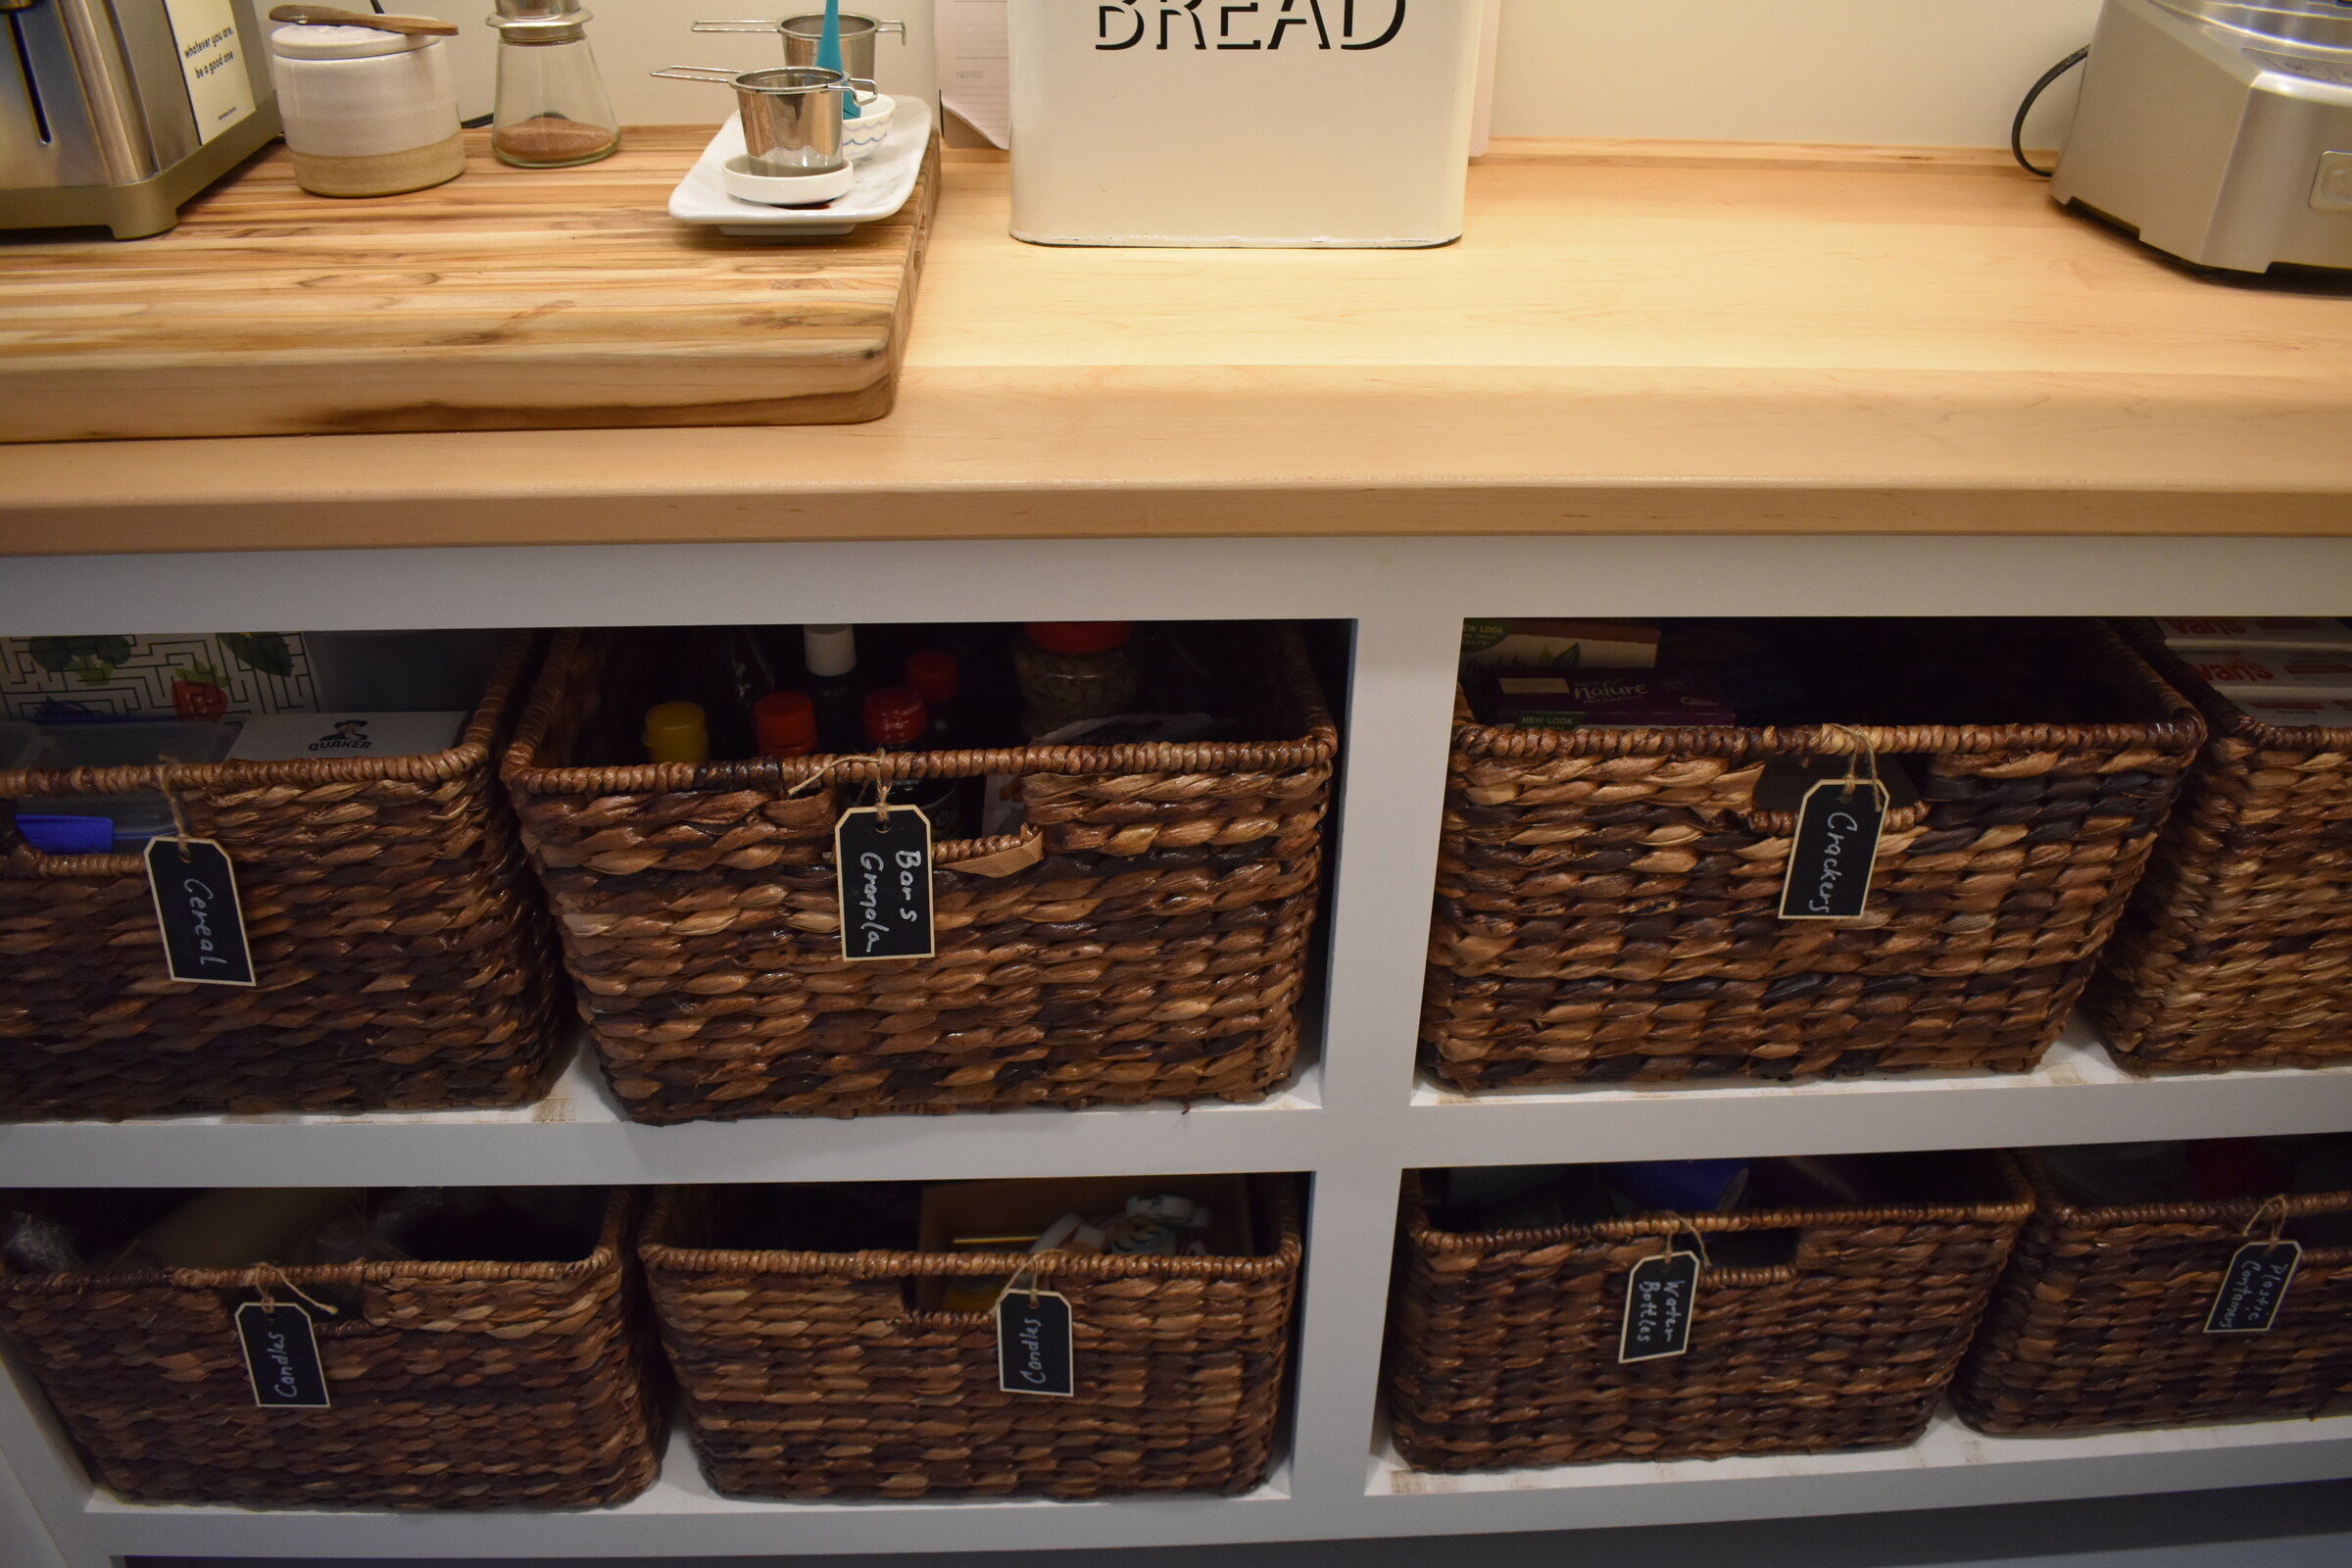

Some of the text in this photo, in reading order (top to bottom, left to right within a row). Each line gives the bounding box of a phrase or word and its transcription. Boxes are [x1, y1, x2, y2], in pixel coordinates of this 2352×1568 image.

[183, 38, 210, 59] whatever
[211, 31, 222, 48] you
[1095, 0, 1406, 50] BREAD
[194, 67, 204, 79] be
[209, 53, 223, 74] good
[223, 50, 234, 63] one
[1521, 715, 1575, 726] NEW LOOK
[1574, 682, 1648, 700] nature
[309, 740, 372, 752] QUAKER
[1808, 811, 1858, 913] Crackers
[183, 878, 227, 965] Cereal
[859, 852, 890, 953] Granola
[1637, 1281, 1661, 1343] Bottles
[1663, 1280, 1686, 1343] Water
[2247, 1263, 2288, 1321] Plastic
[267, 1331, 298, 1397] Candles
[1019, 1318, 1047, 1384] Candles
